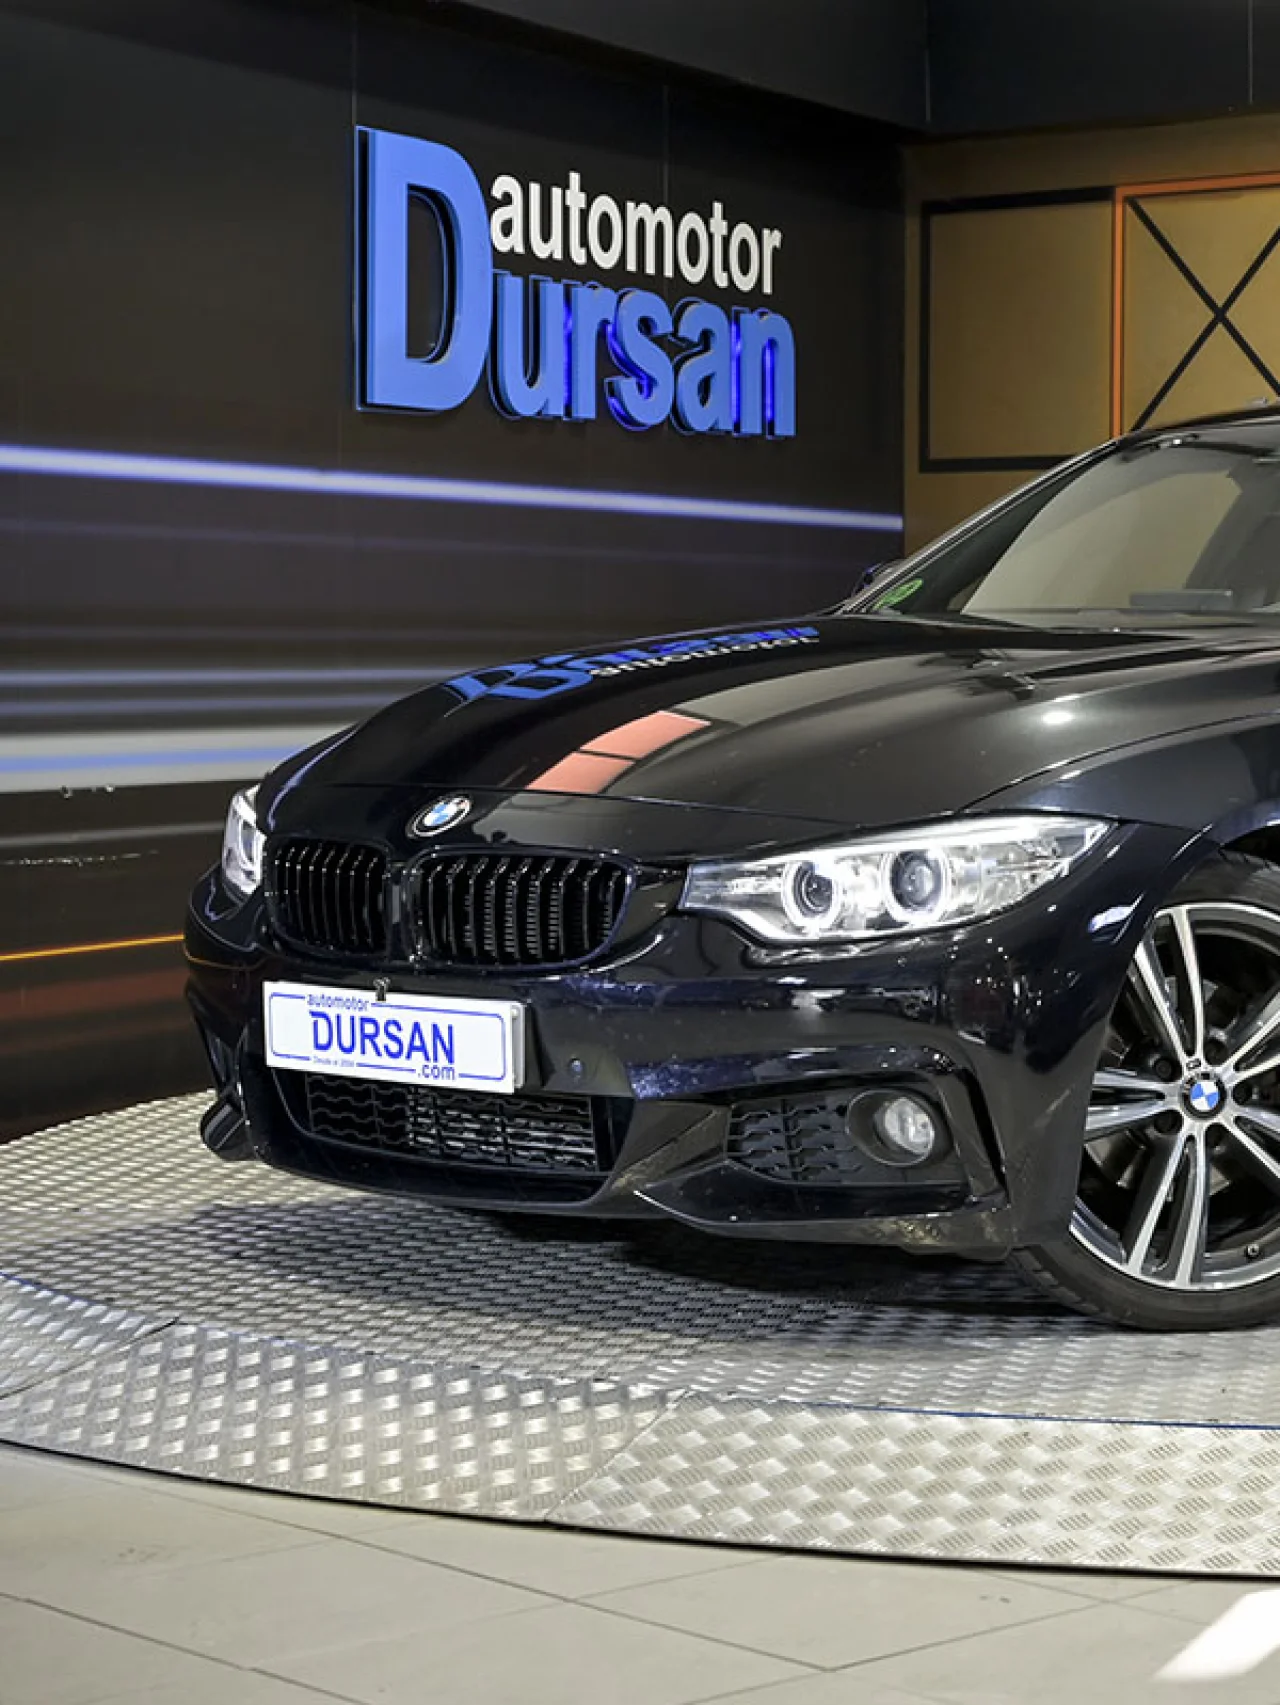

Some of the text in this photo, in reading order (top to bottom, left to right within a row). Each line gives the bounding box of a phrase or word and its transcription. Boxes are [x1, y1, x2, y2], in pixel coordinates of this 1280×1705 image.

[490, 171, 782, 294] automotor
[355, 125, 797, 438] Dursan
[308, 994, 369, 1011] automotor
[310, 1011, 455, 1064] DURSAN
[418, 1063, 455, 1080] .com
